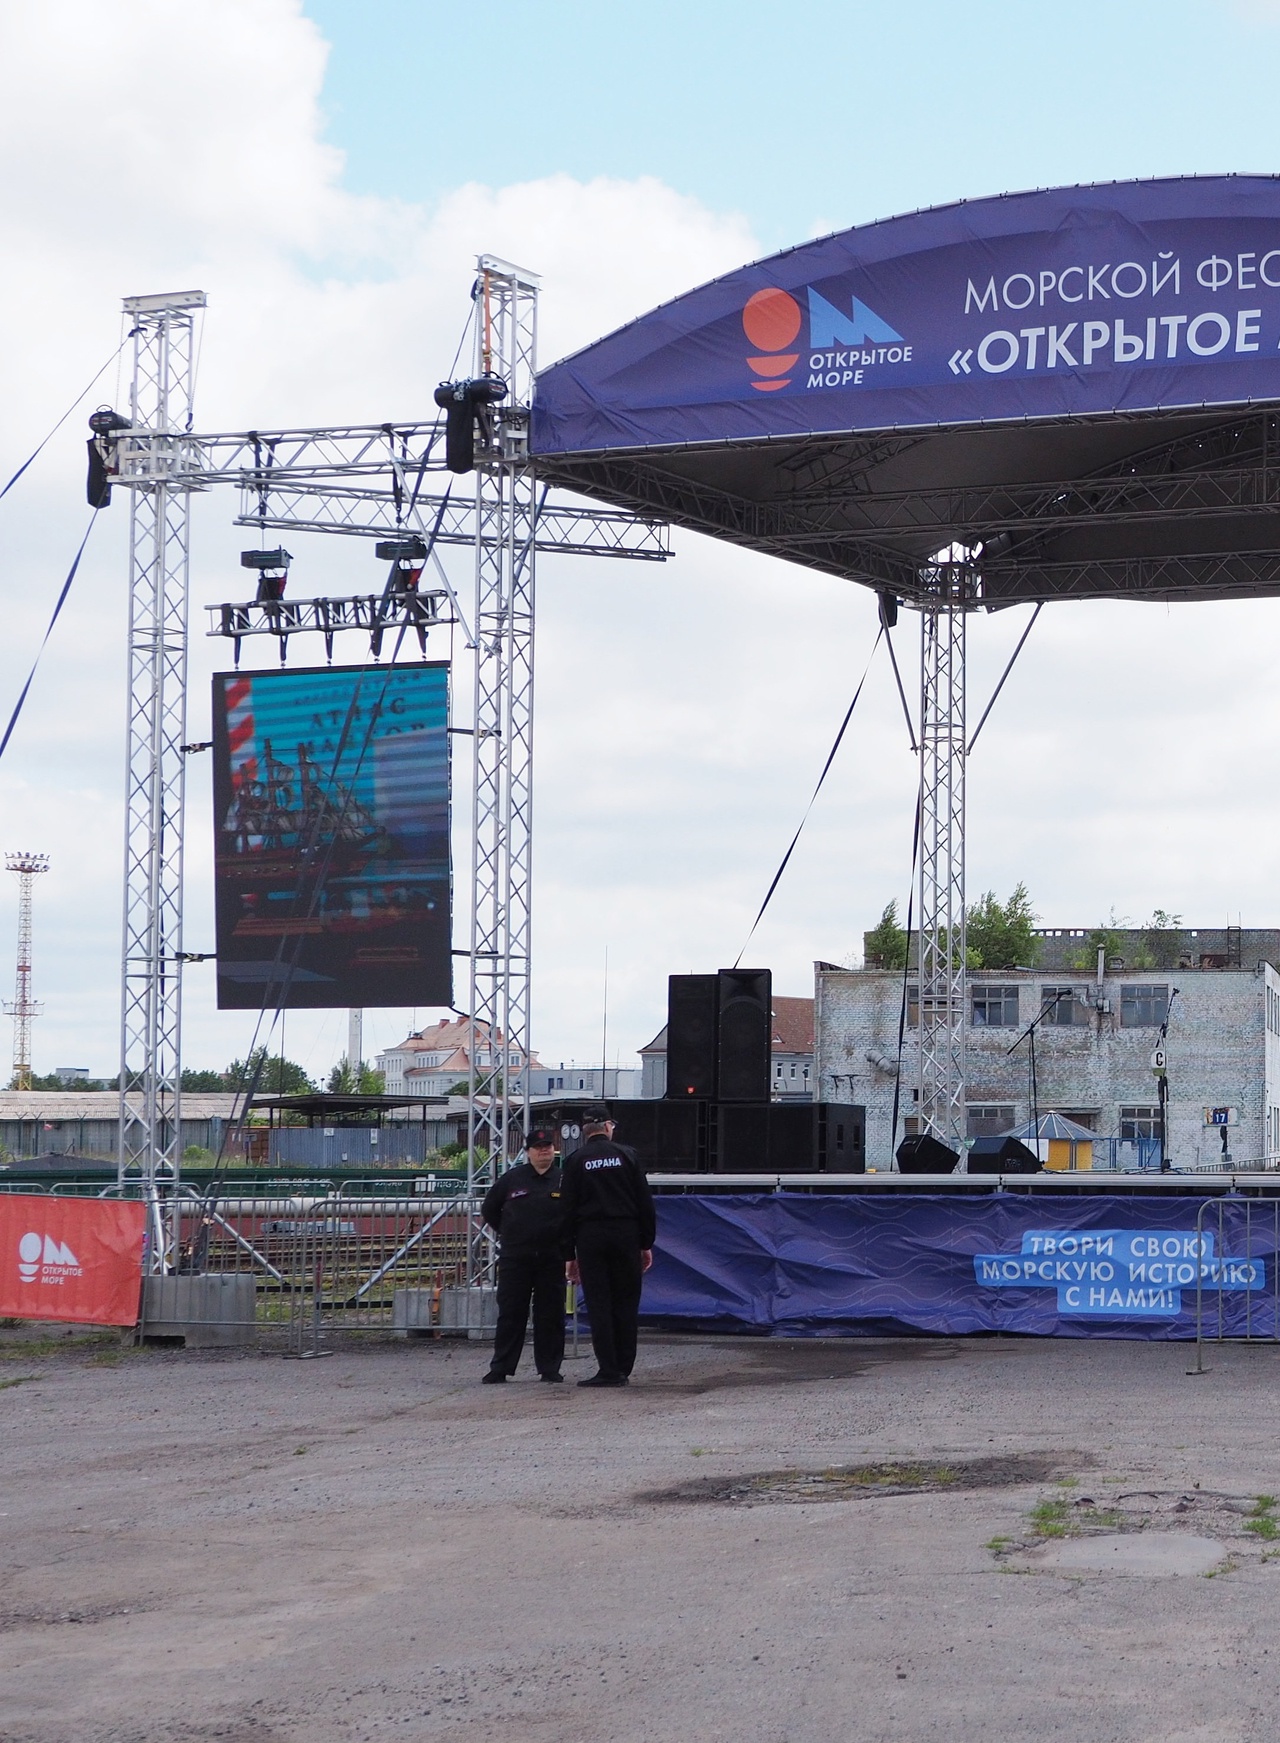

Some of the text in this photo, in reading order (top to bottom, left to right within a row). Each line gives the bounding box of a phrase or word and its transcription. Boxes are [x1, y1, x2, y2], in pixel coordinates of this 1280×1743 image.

[964, 252, 1183, 315] МОРСКОЙ
[947, 309, 1261, 376] «ОТКРЫТОЕ
[809, 346, 913, 370] ОТКРЫТОЕ
[806, 370, 863, 389] МОРЕ
[1215, 1113, 1226, 1123] 17
[585, 1157, 621, 1170] ОХРАНА
[1030, 1236, 1207, 1259] ТВОРИ СВОЮ
[41, 1276, 64, 1285] МОРЕ
[42, 1266, 83, 1277] ОТКРЫТОЕ
[982, 1261, 1256, 1284] МОРСКУЮ ИСТОРИЮ
[1065, 1286, 1174, 1309] С НАМИ!
